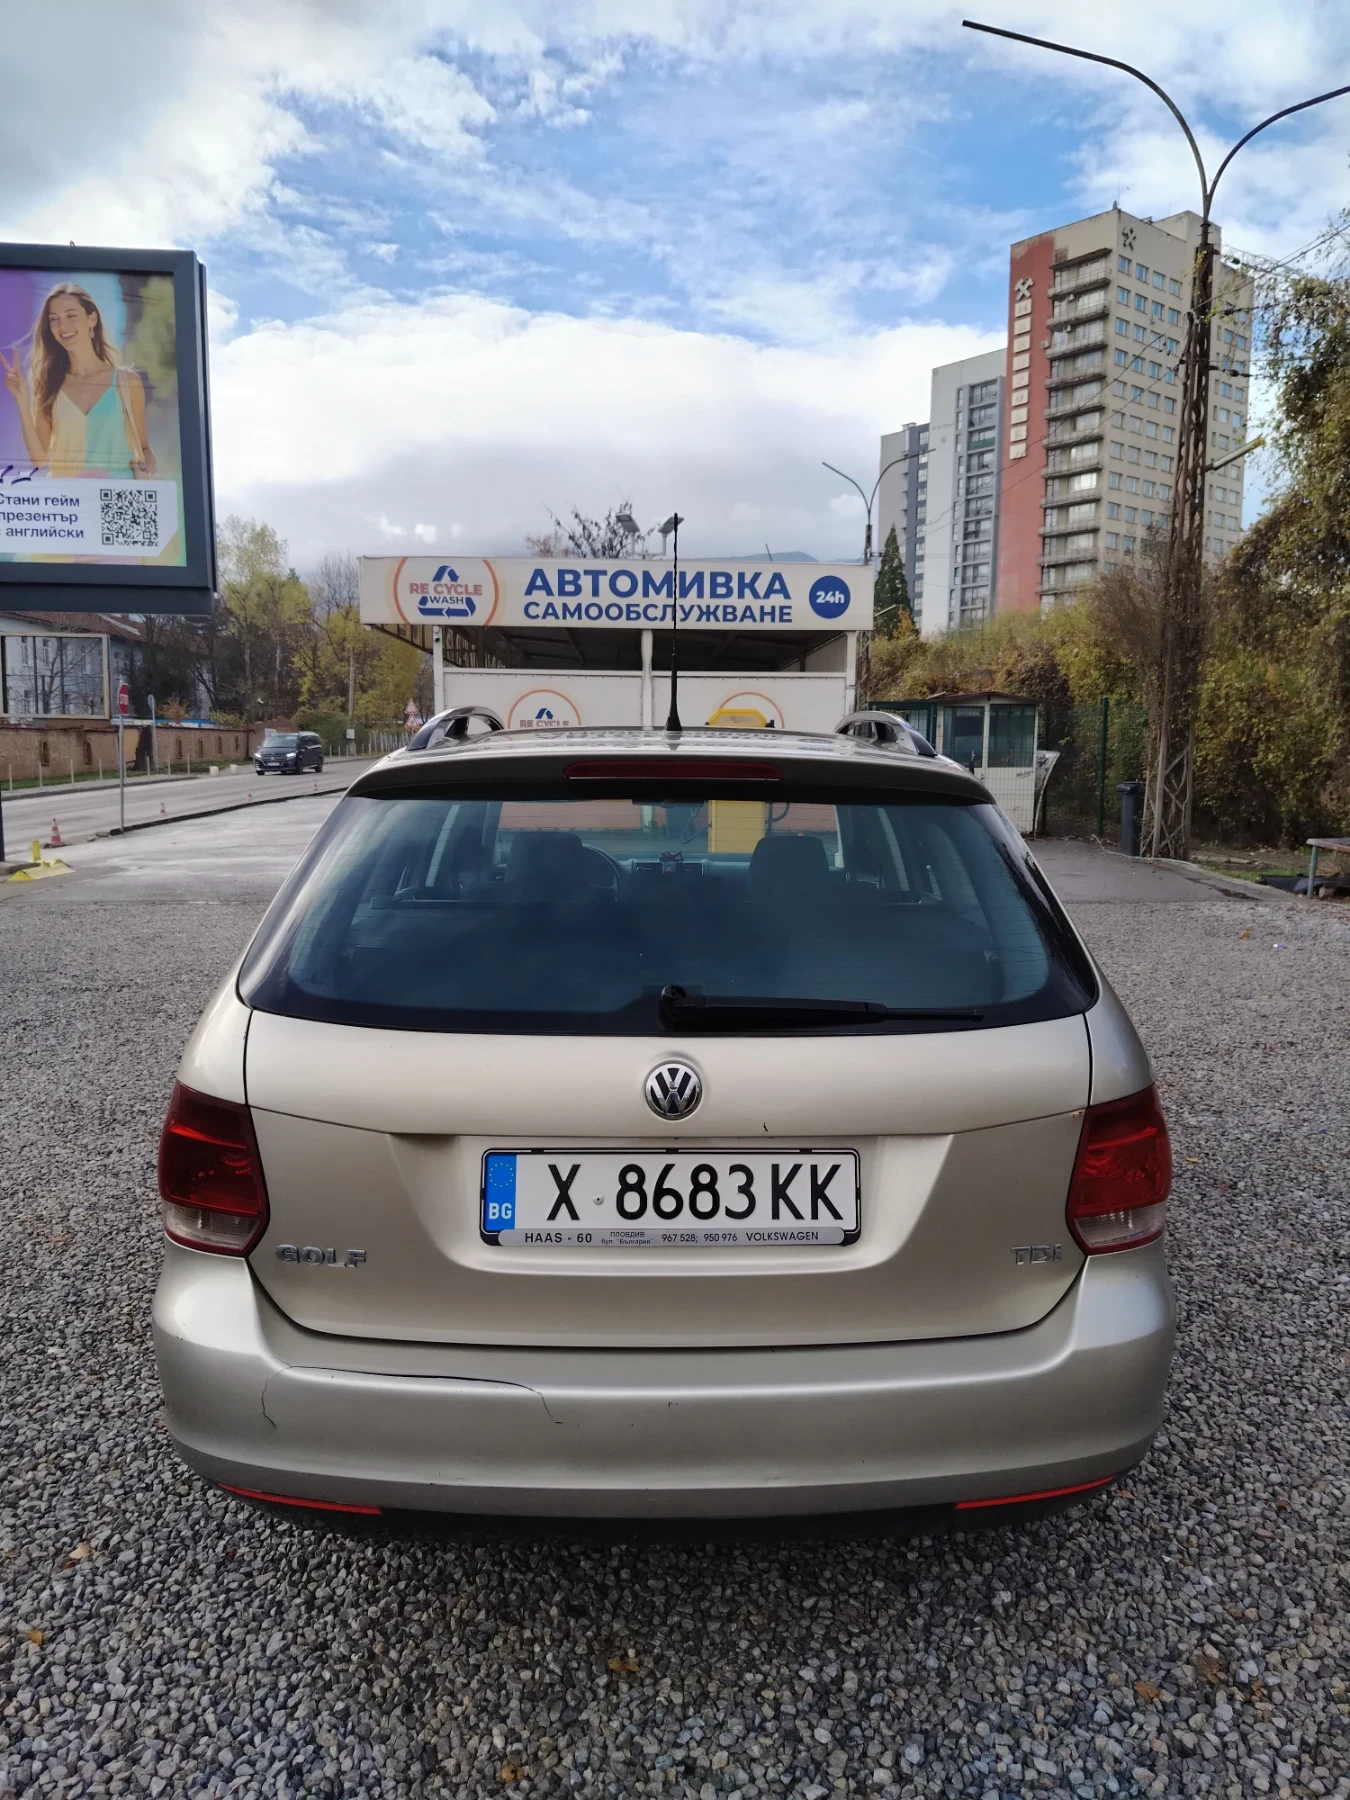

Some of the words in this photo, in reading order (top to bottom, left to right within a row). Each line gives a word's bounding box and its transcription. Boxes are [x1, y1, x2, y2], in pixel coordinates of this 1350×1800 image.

[45, 494, 80, 507] гейм
[6, 526, 84, 538] английски
[409, 583, 429, 594] RE
[434, 583, 483, 596] CYCLE
[524, 568, 791, 600] АВТОМИВКА
[430, 596, 464, 604] WASH
[816, 591, 845, 604] 24h
[523, 601, 792, 623] САМООБСЛУЖВАНЕ
[519, 719, 533, 728] RE
[546, 1163, 581, 1221] X
[615, 1163, 756, 1221] 8683
[771, 1163, 844, 1221] KK
[489, 1203, 512, 1220] BG
[525, 1232, 563, 1243] HAAS
[577, 1233, 592, 1243] 60
[661, 1233, 678, 1242] 967
[679, 1233, 698, 1243] 528;
[703, 1233, 720, 1242] 950
[721, 1233, 738, 1242] 976
[746, 1231, 819, 1242] VOLKSWAGEN
[275, 1244, 367, 1268] GOLF
[1011, 1243, 1062, 1266] TDI
